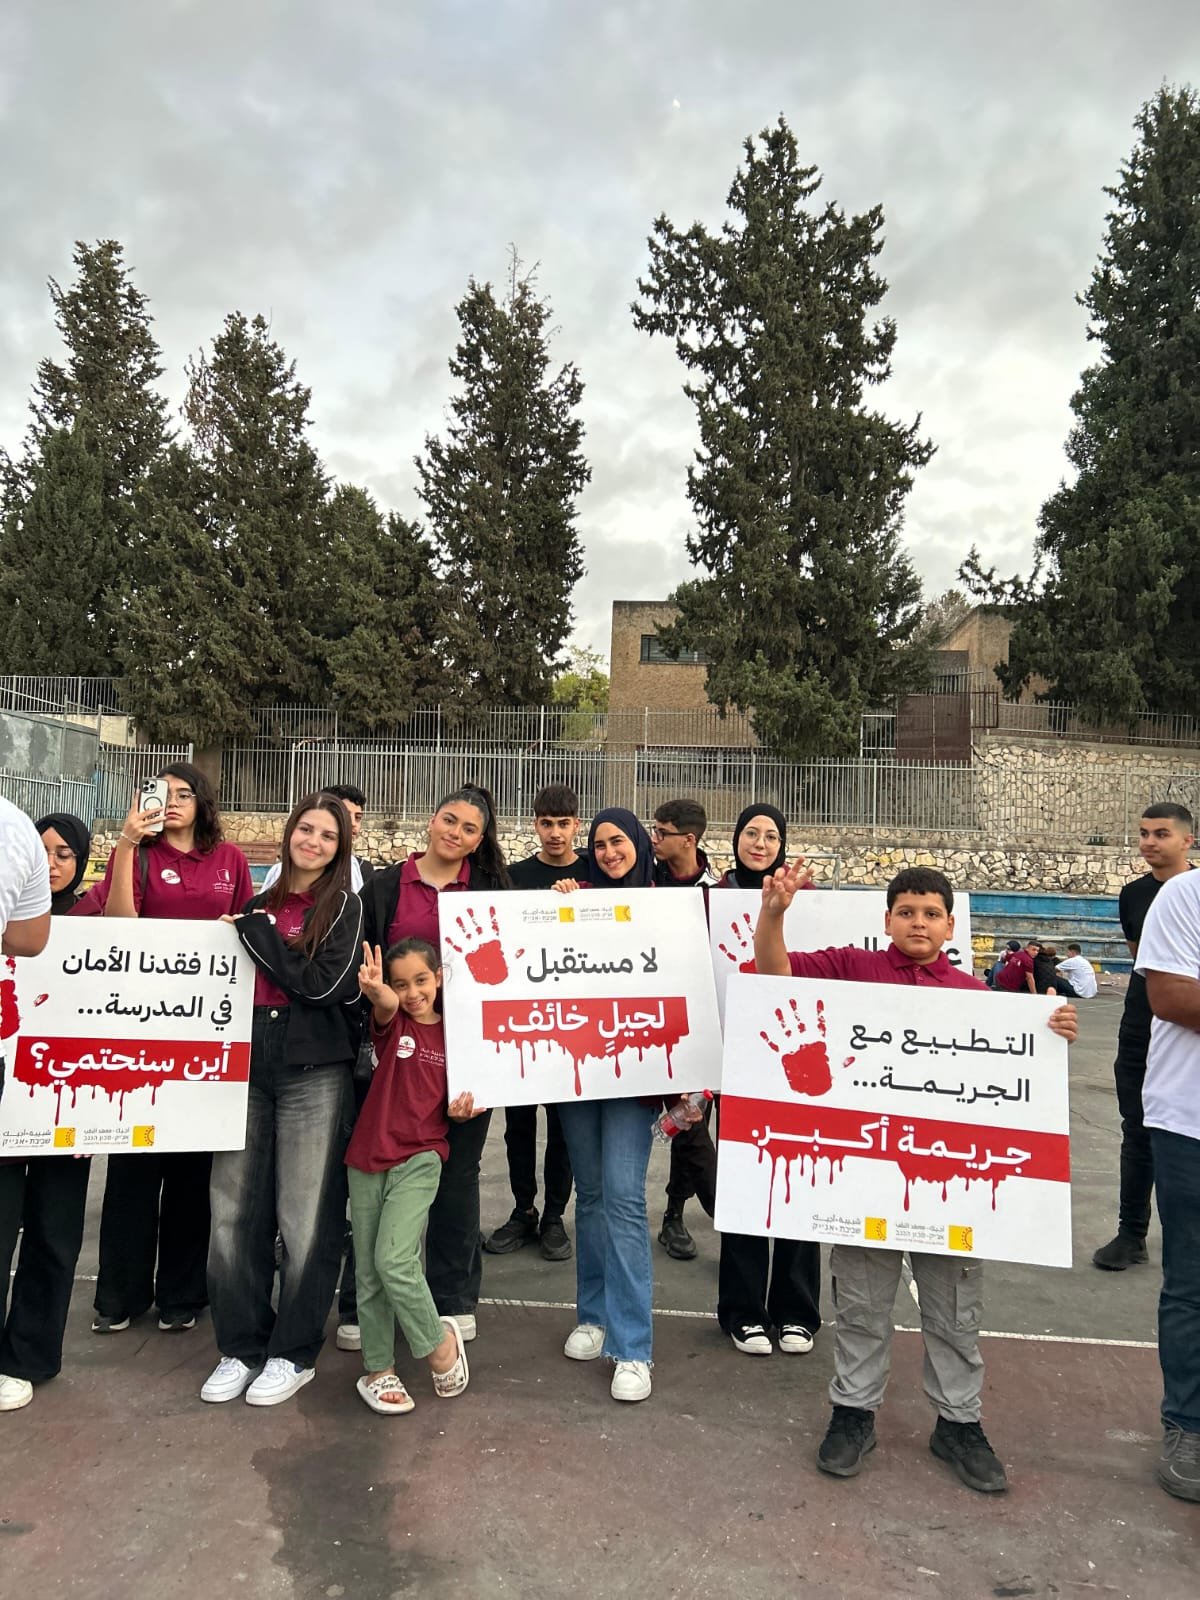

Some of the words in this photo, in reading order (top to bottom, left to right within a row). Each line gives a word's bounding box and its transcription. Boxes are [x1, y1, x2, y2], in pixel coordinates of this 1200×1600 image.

[62, 945, 131, 976] الأمان
[139, 951, 202, 976] فقدنا
[209, 954, 238, 985] إذا
[526, 947, 634, 983] مستقبل
[640, 947, 659, 974] لا
[77, 992, 204, 1022] المدرسة...
[210, 992, 233, 1032] في
[497, 1001, 589, 1034] خائف.
[849, 1024, 893, 1051] مع
[29, 1041, 176, 1087] سنحتمي؟
[183, 1041, 233, 1082] أين
[750, 1115, 890, 1153] أكبر.
[896, 1124, 1033, 1175] جريمة
